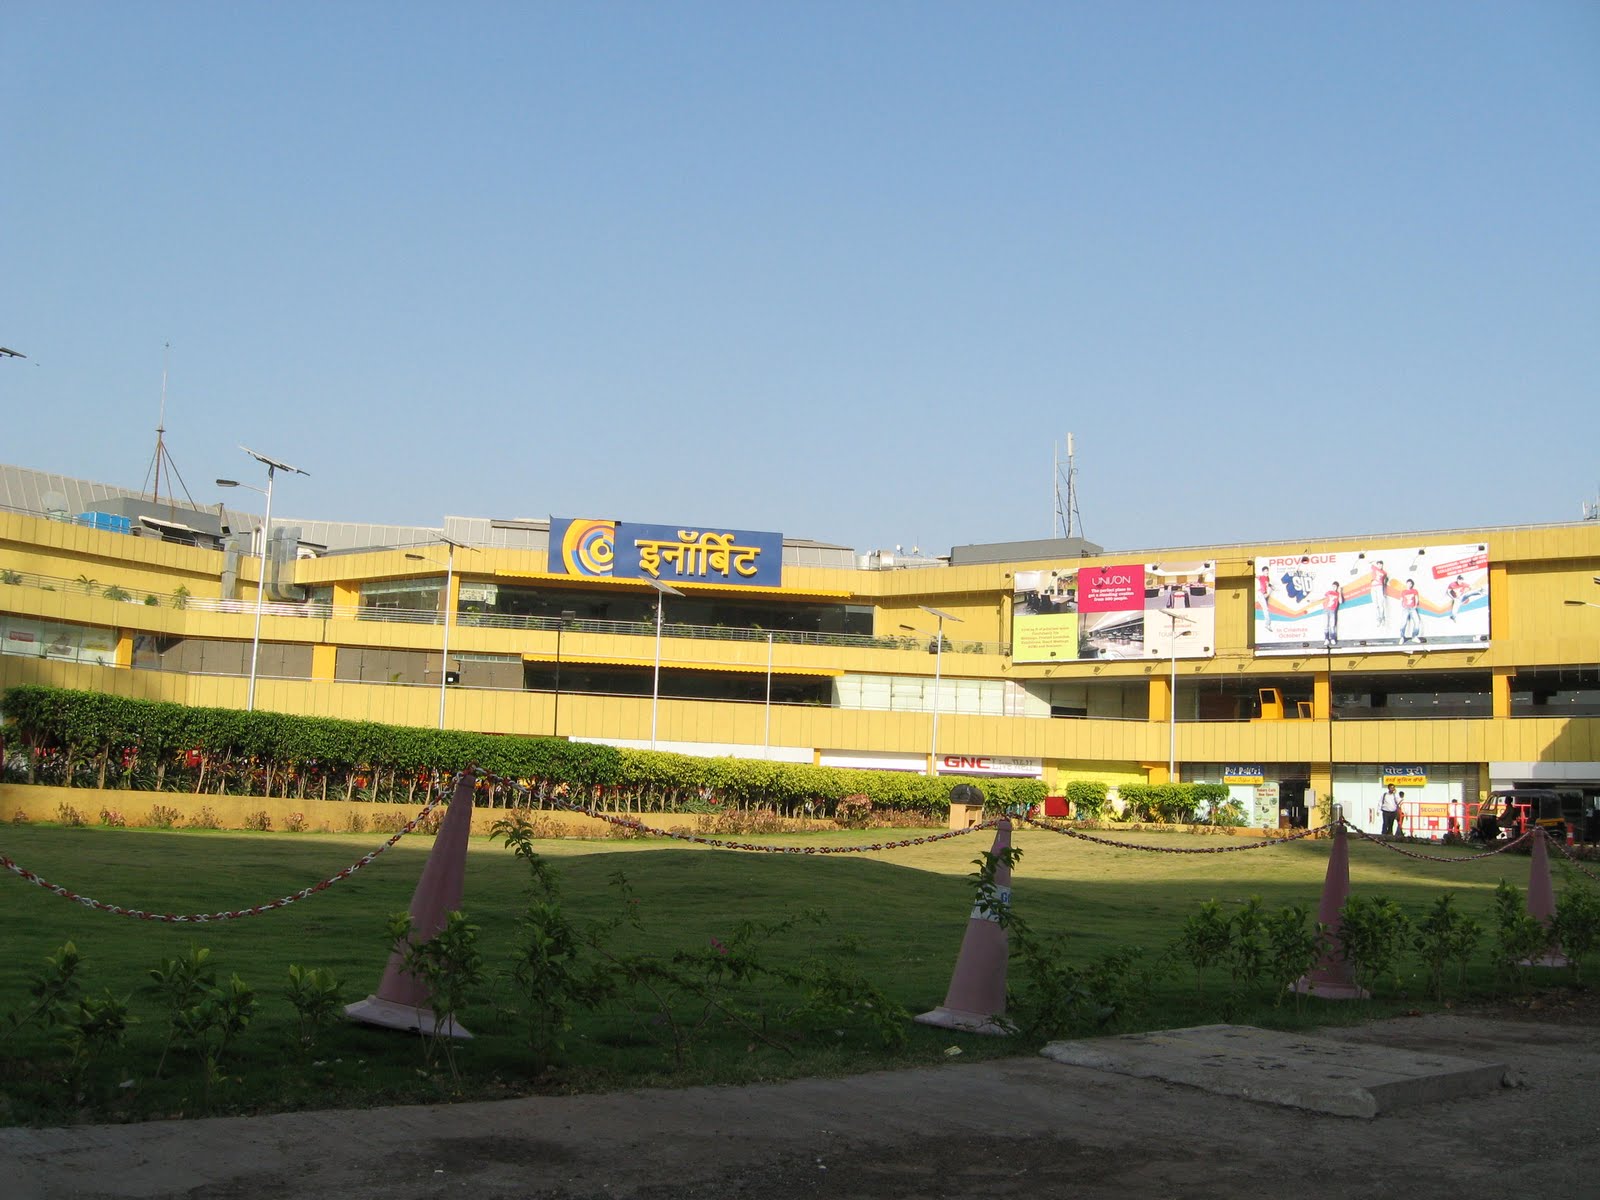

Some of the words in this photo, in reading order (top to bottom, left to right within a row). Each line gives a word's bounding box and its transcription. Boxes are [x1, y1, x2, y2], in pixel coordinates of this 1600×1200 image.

[634, 530, 761, 579] इनॉर्बिट
[1269, 555, 1336, 567] PROVOGUE
[1091, 575, 1131, 586] UNISON
[944, 756, 991, 769] GNC
